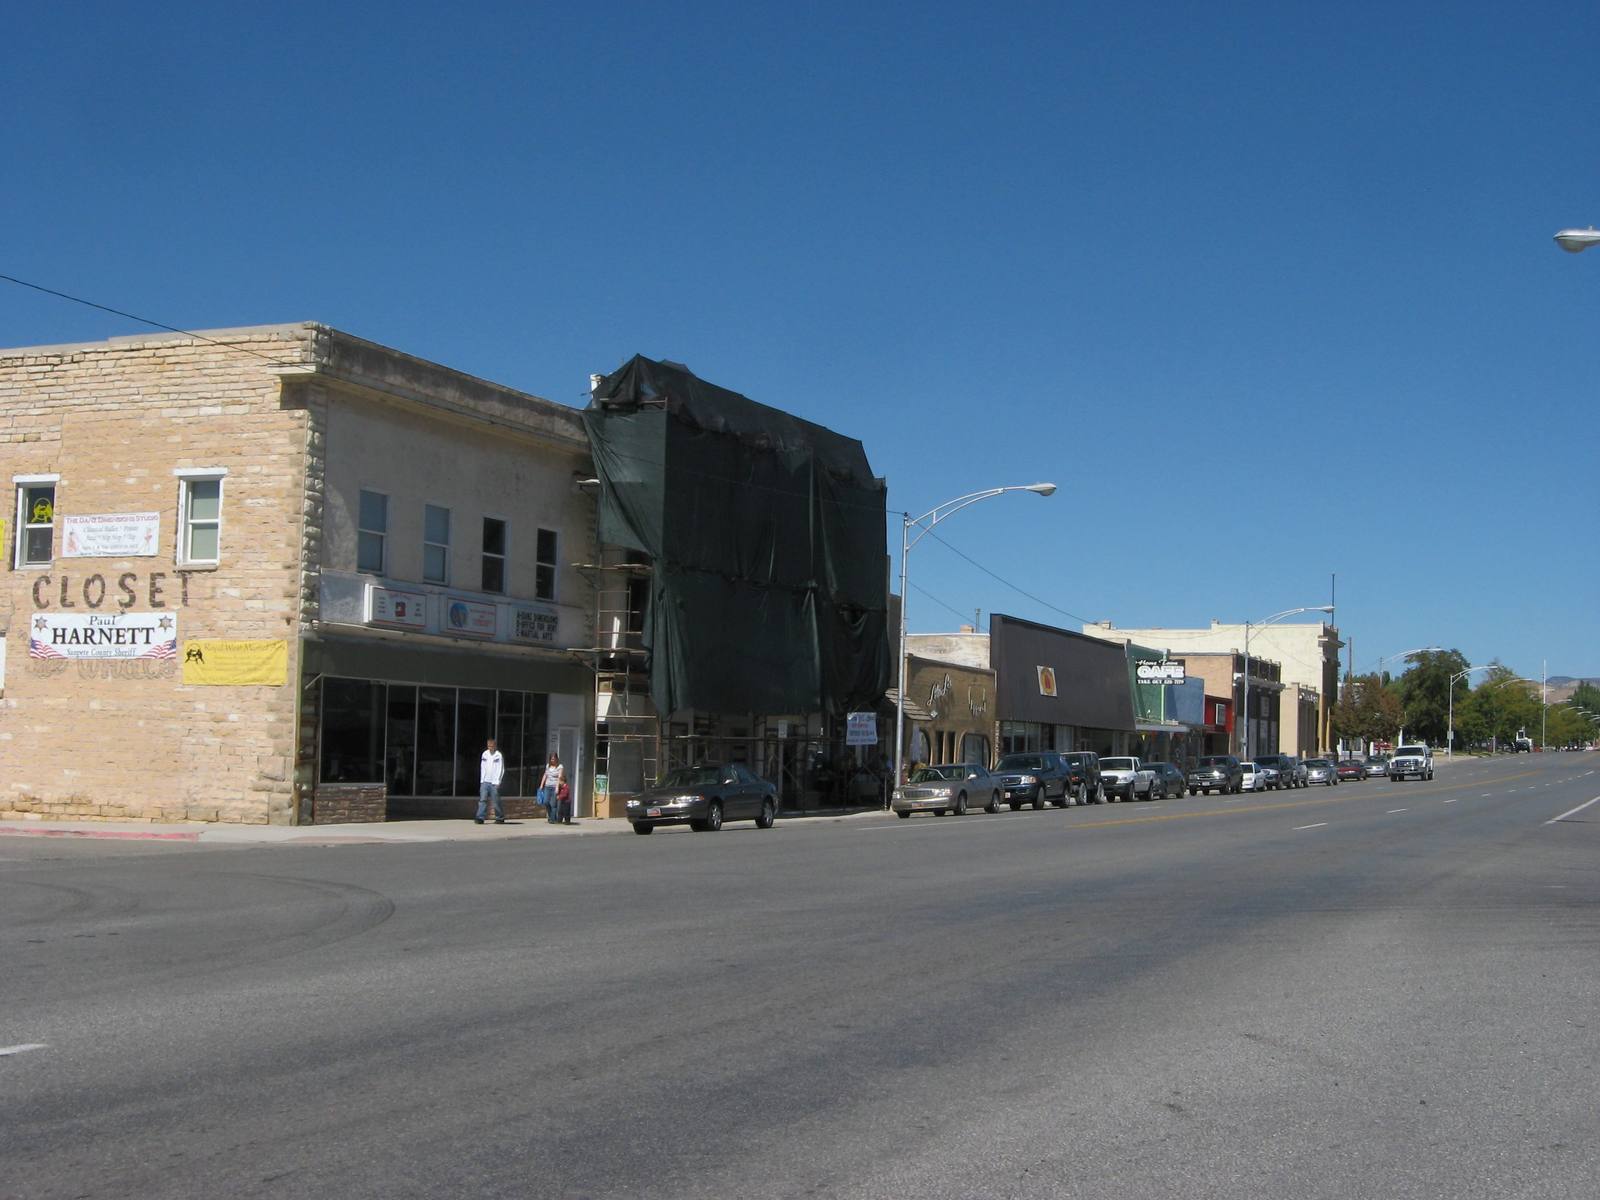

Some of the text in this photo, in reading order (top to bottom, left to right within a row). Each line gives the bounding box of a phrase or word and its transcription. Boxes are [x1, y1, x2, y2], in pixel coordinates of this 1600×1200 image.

[32, 571, 193, 609] CLOSET
[89, 615, 116, 626] Paul
[51, 627, 155, 645] HARNETT
[90, 648, 113, 658] County
[114, 647, 137, 656] Sheriff
[1136, 665, 1185, 678] CAFE
